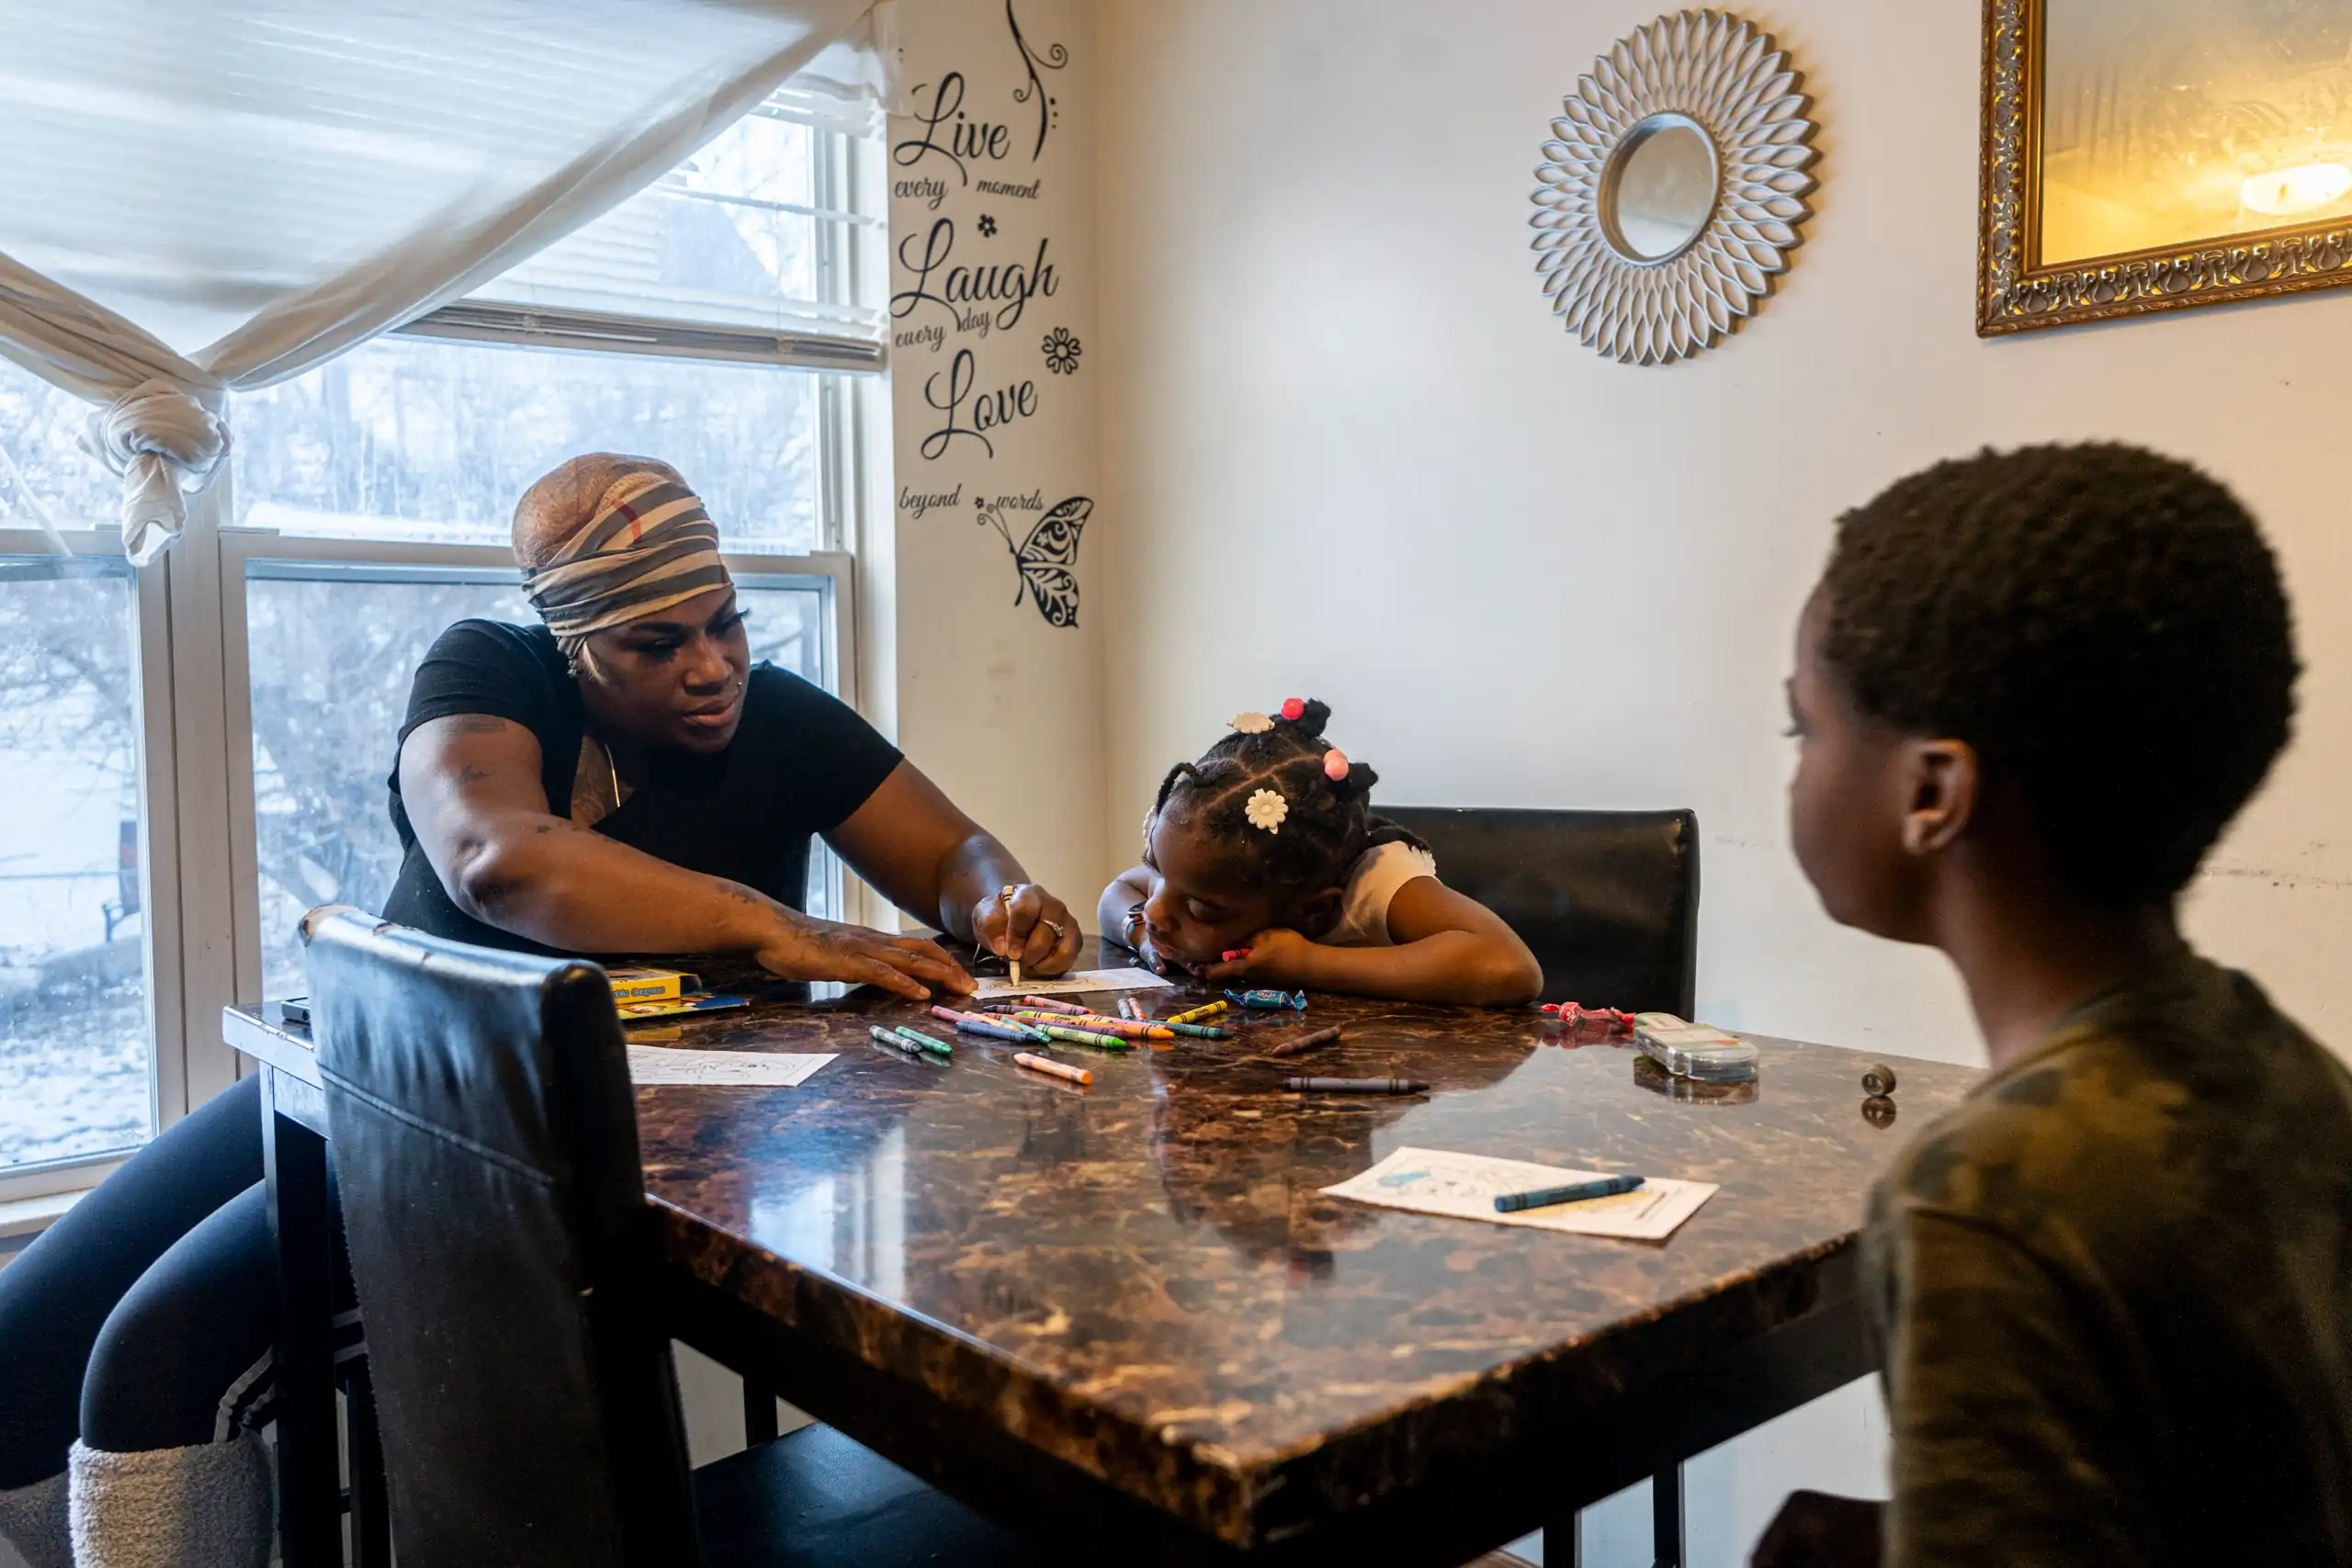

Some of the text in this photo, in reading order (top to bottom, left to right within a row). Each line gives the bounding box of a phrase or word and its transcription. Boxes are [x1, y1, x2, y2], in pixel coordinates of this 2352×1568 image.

[894, 72, 1010, 186] Live
[894, 175, 1041, 210] every moment
[888, 217, 1059, 331] Laugh
[895, 307, 992, 353] every day
[921, 348, 1038, 460] Love
[899, 483, 1046, 519] beyond words
